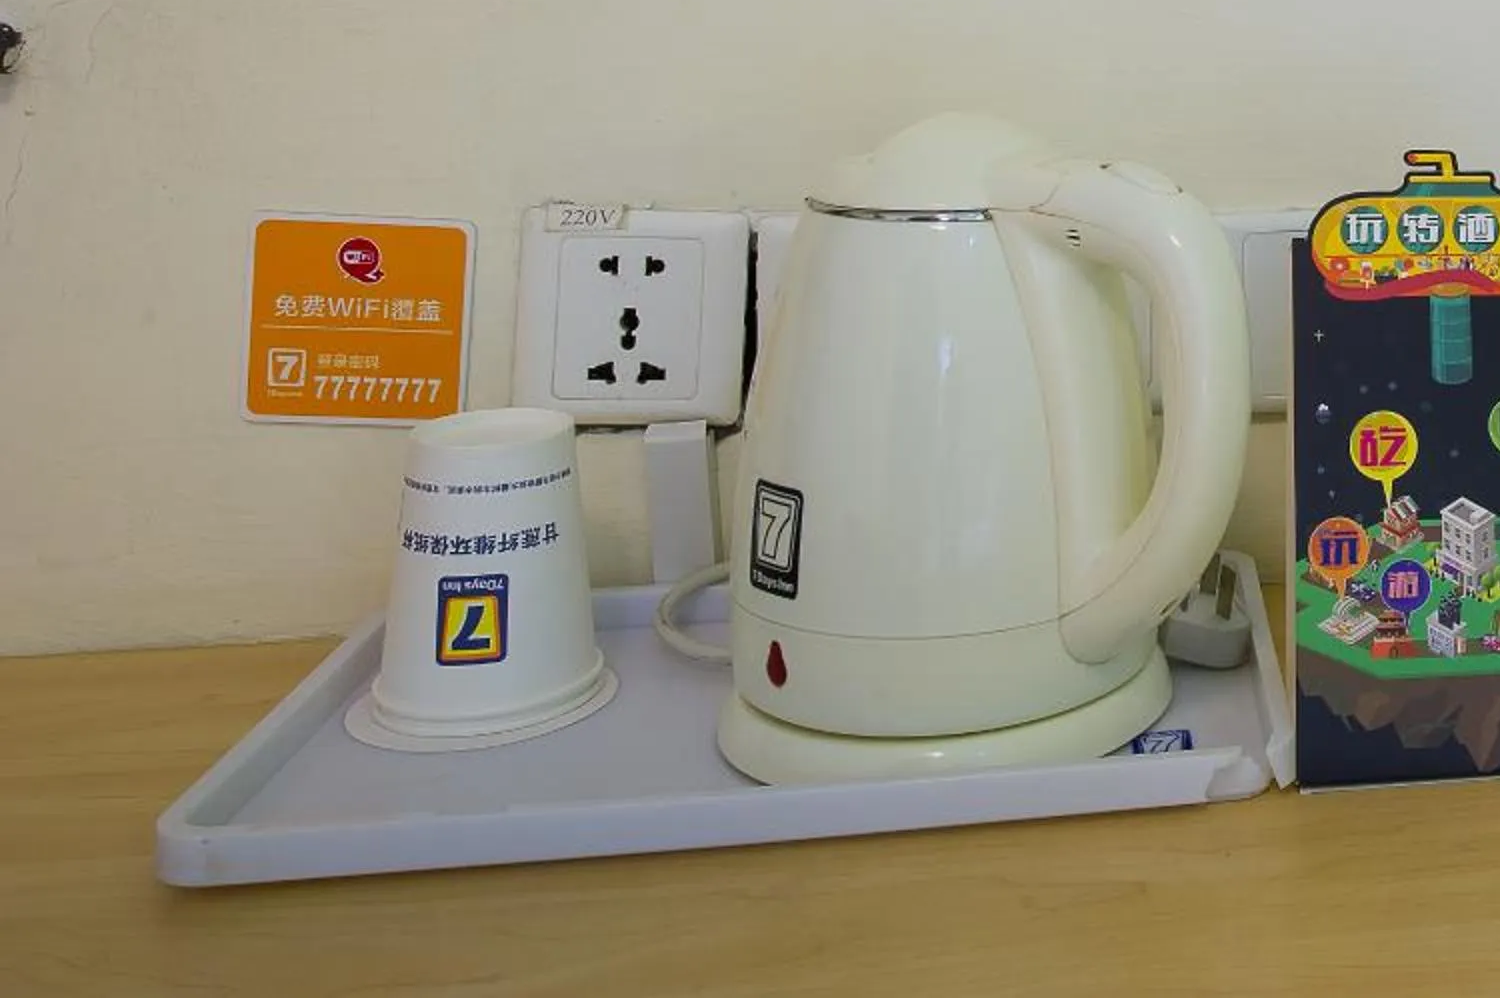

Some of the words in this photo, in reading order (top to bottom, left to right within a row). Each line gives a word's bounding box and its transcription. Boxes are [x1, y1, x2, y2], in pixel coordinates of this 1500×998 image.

[560, 209, 616, 226] 220V
[275, 294, 442, 322] 免费WiFi覆盖
[314, 375, 442, 403] 77777777
[1360, 426, 1406, 467] 吃
[762, 498, 792, 559] 7
[451, 605, 491, 651] 7
